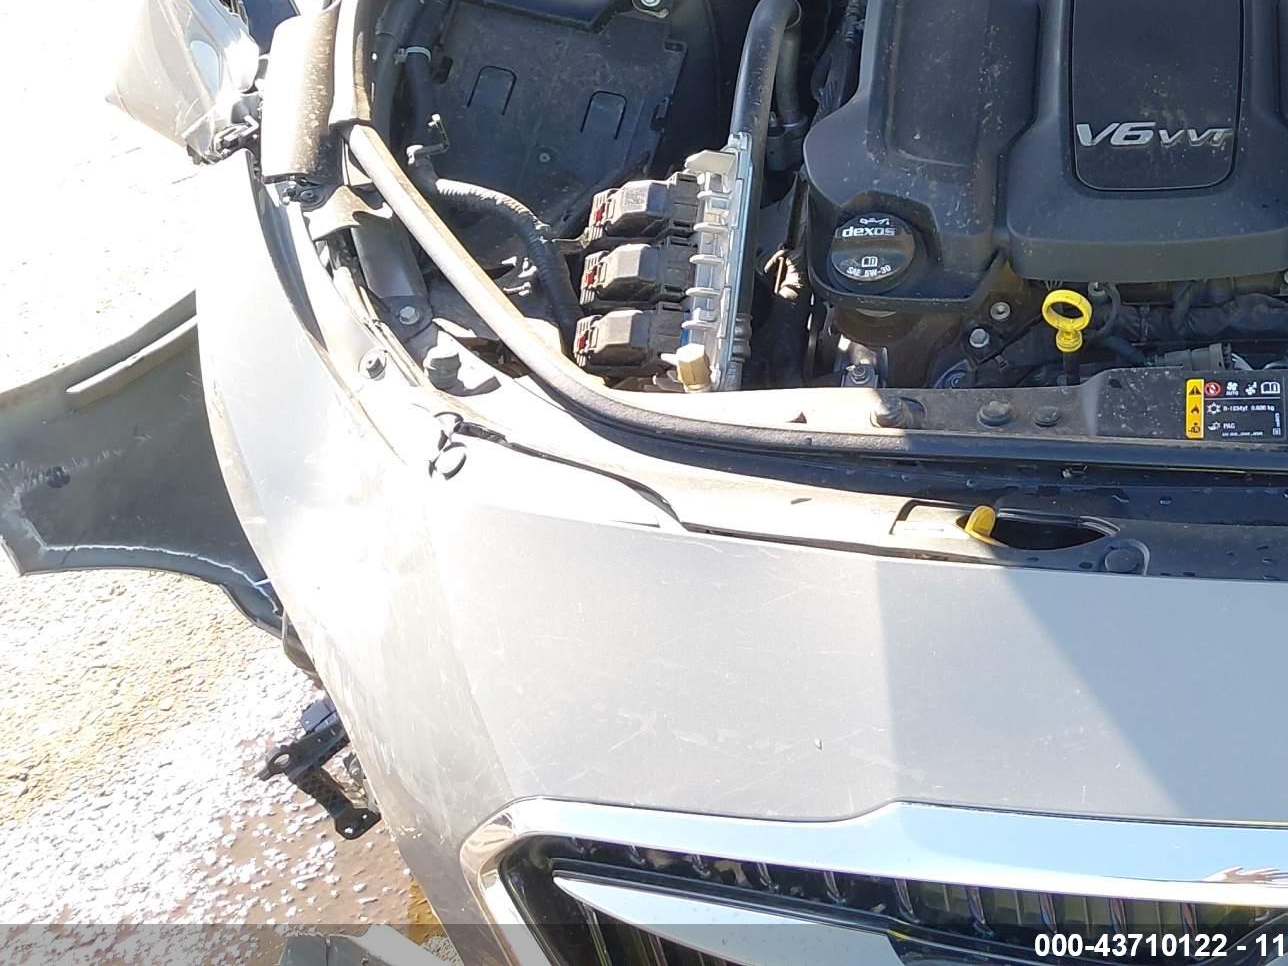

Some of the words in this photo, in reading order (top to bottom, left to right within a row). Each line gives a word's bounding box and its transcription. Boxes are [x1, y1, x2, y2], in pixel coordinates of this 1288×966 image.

[1076, 122, 1156, 146] V6
[1159, 128, 1233, 146] VVT
[842, 226, 896, 237] dexos
[847, 267, 861, 276] SAE
[864, 265, 892, 277] 5W-30
